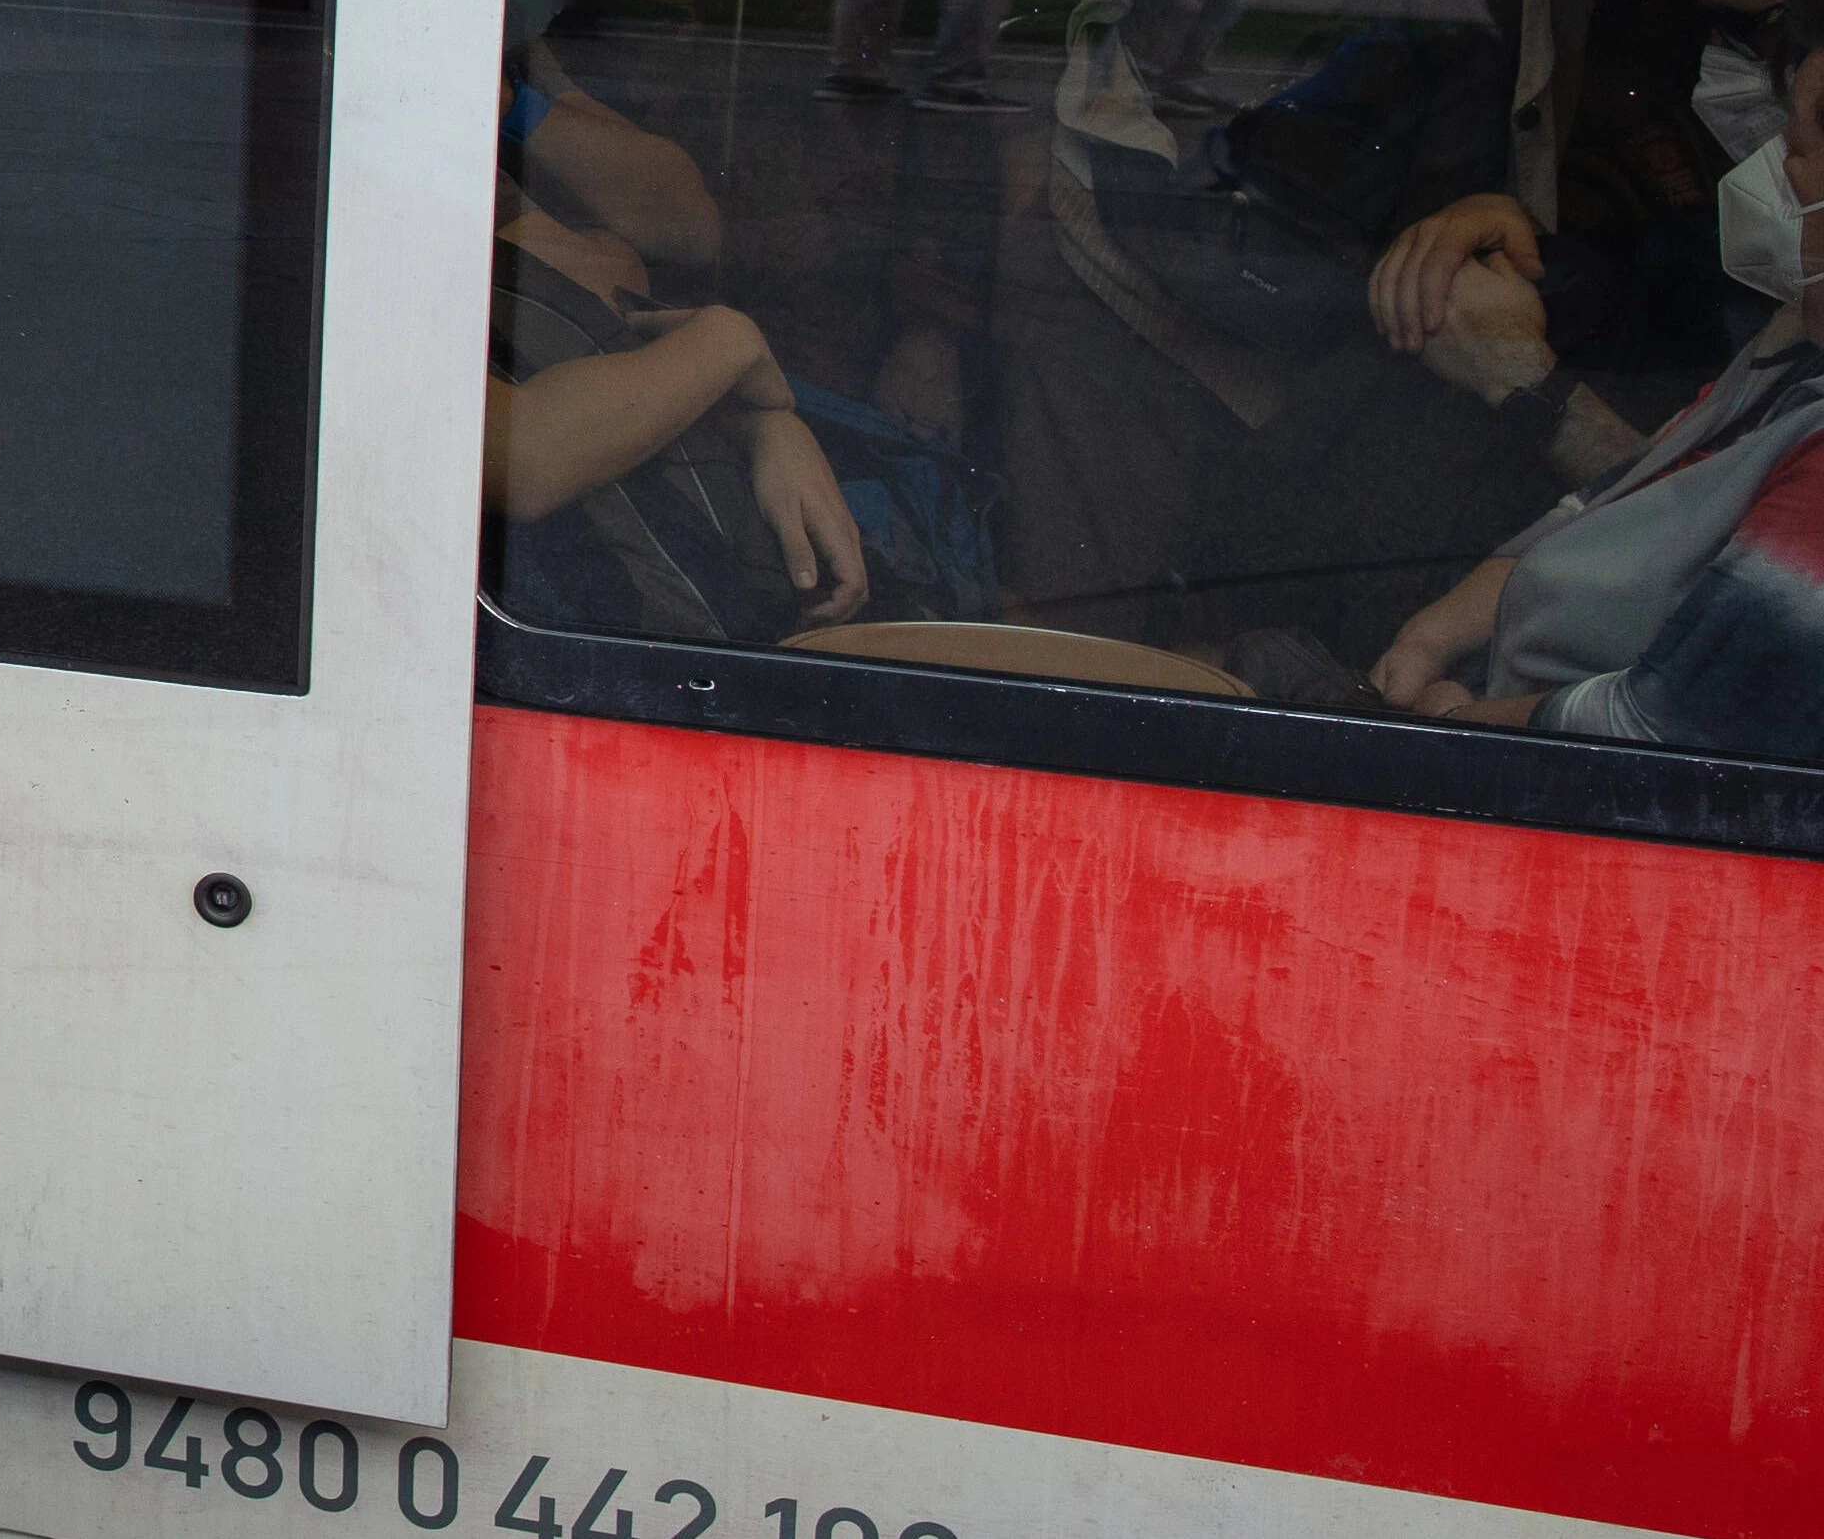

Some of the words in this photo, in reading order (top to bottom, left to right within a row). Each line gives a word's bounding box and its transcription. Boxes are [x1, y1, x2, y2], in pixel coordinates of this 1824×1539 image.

[72, 1379, 359, 1513] 9480
[398, 1436, 459, 1530] 0
[494, 1455, 718, 1539] 442
